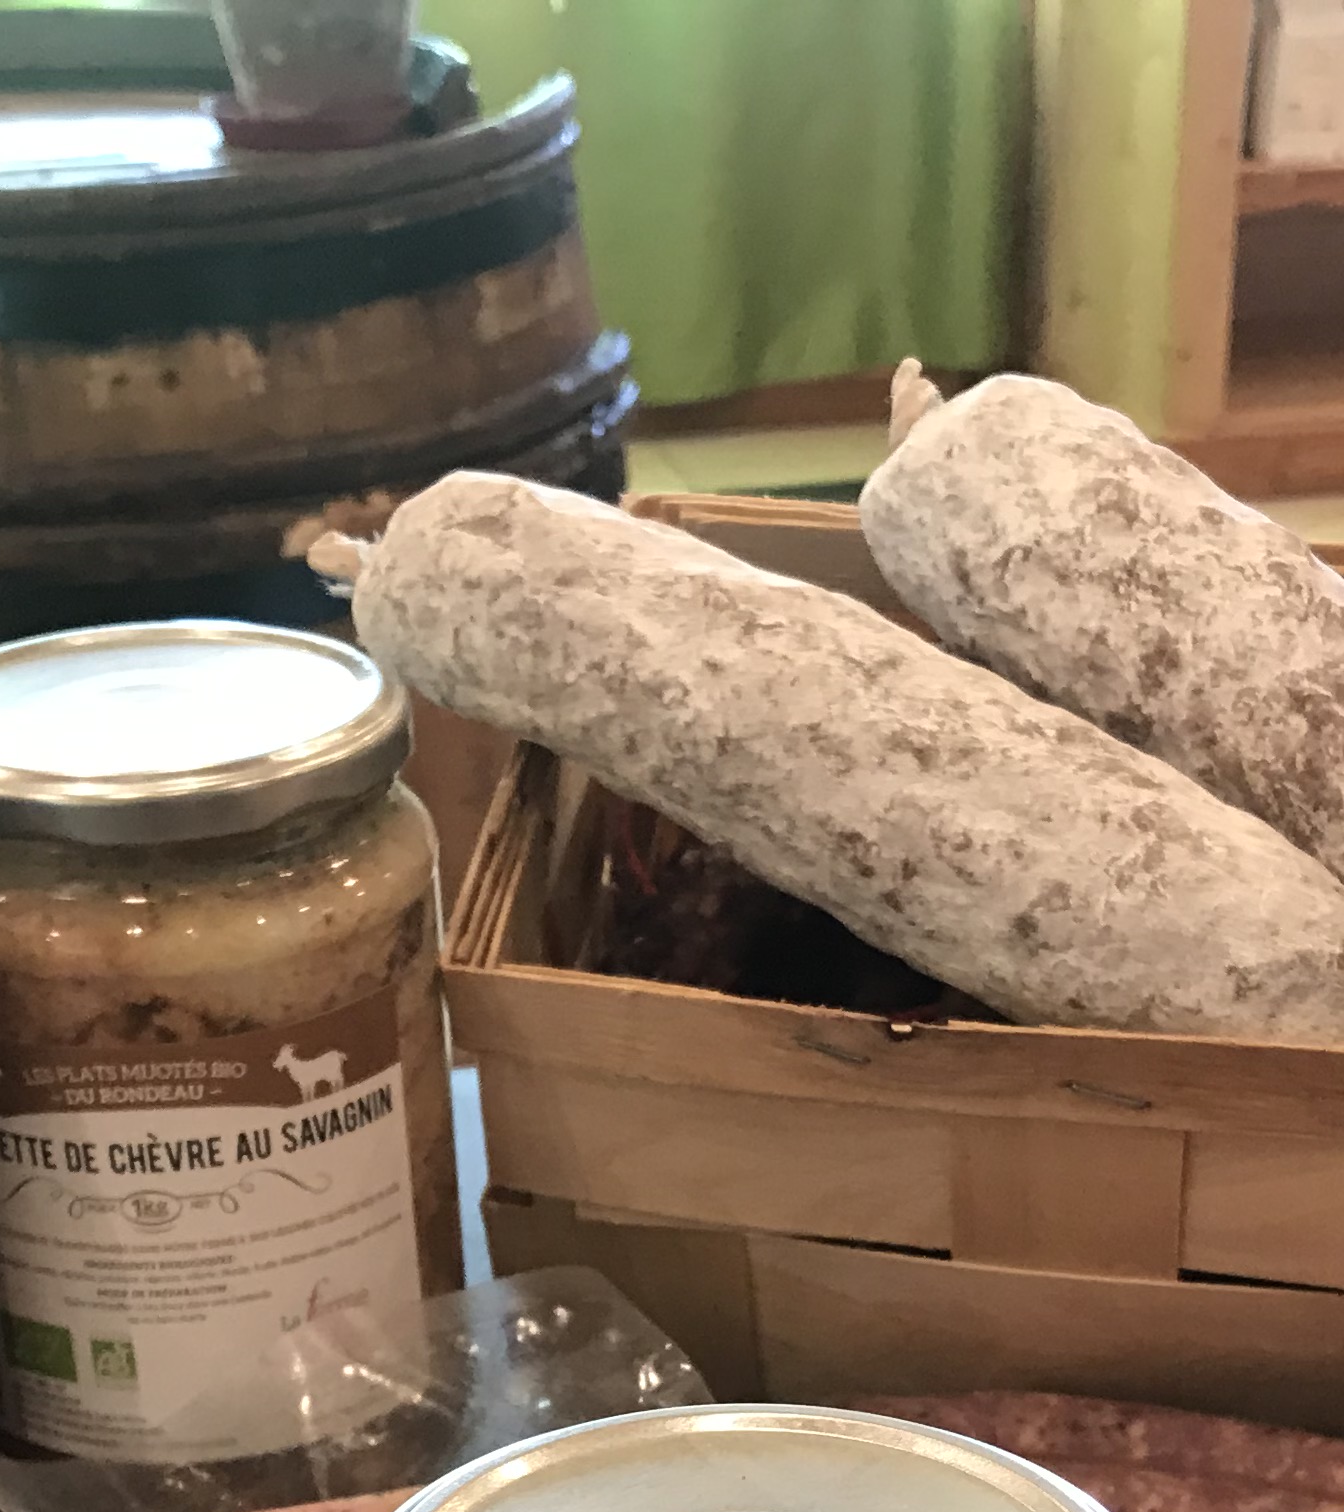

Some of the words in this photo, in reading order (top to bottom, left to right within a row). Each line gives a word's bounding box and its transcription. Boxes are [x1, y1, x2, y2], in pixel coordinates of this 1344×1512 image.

[66, 1142, 99, 1174] DE
[109, 1132, 224, 1174] CHÈVRE
[236, 1127, 273, 1163] AU
[282, 1083, 394, 1154] SAVAGNIN
